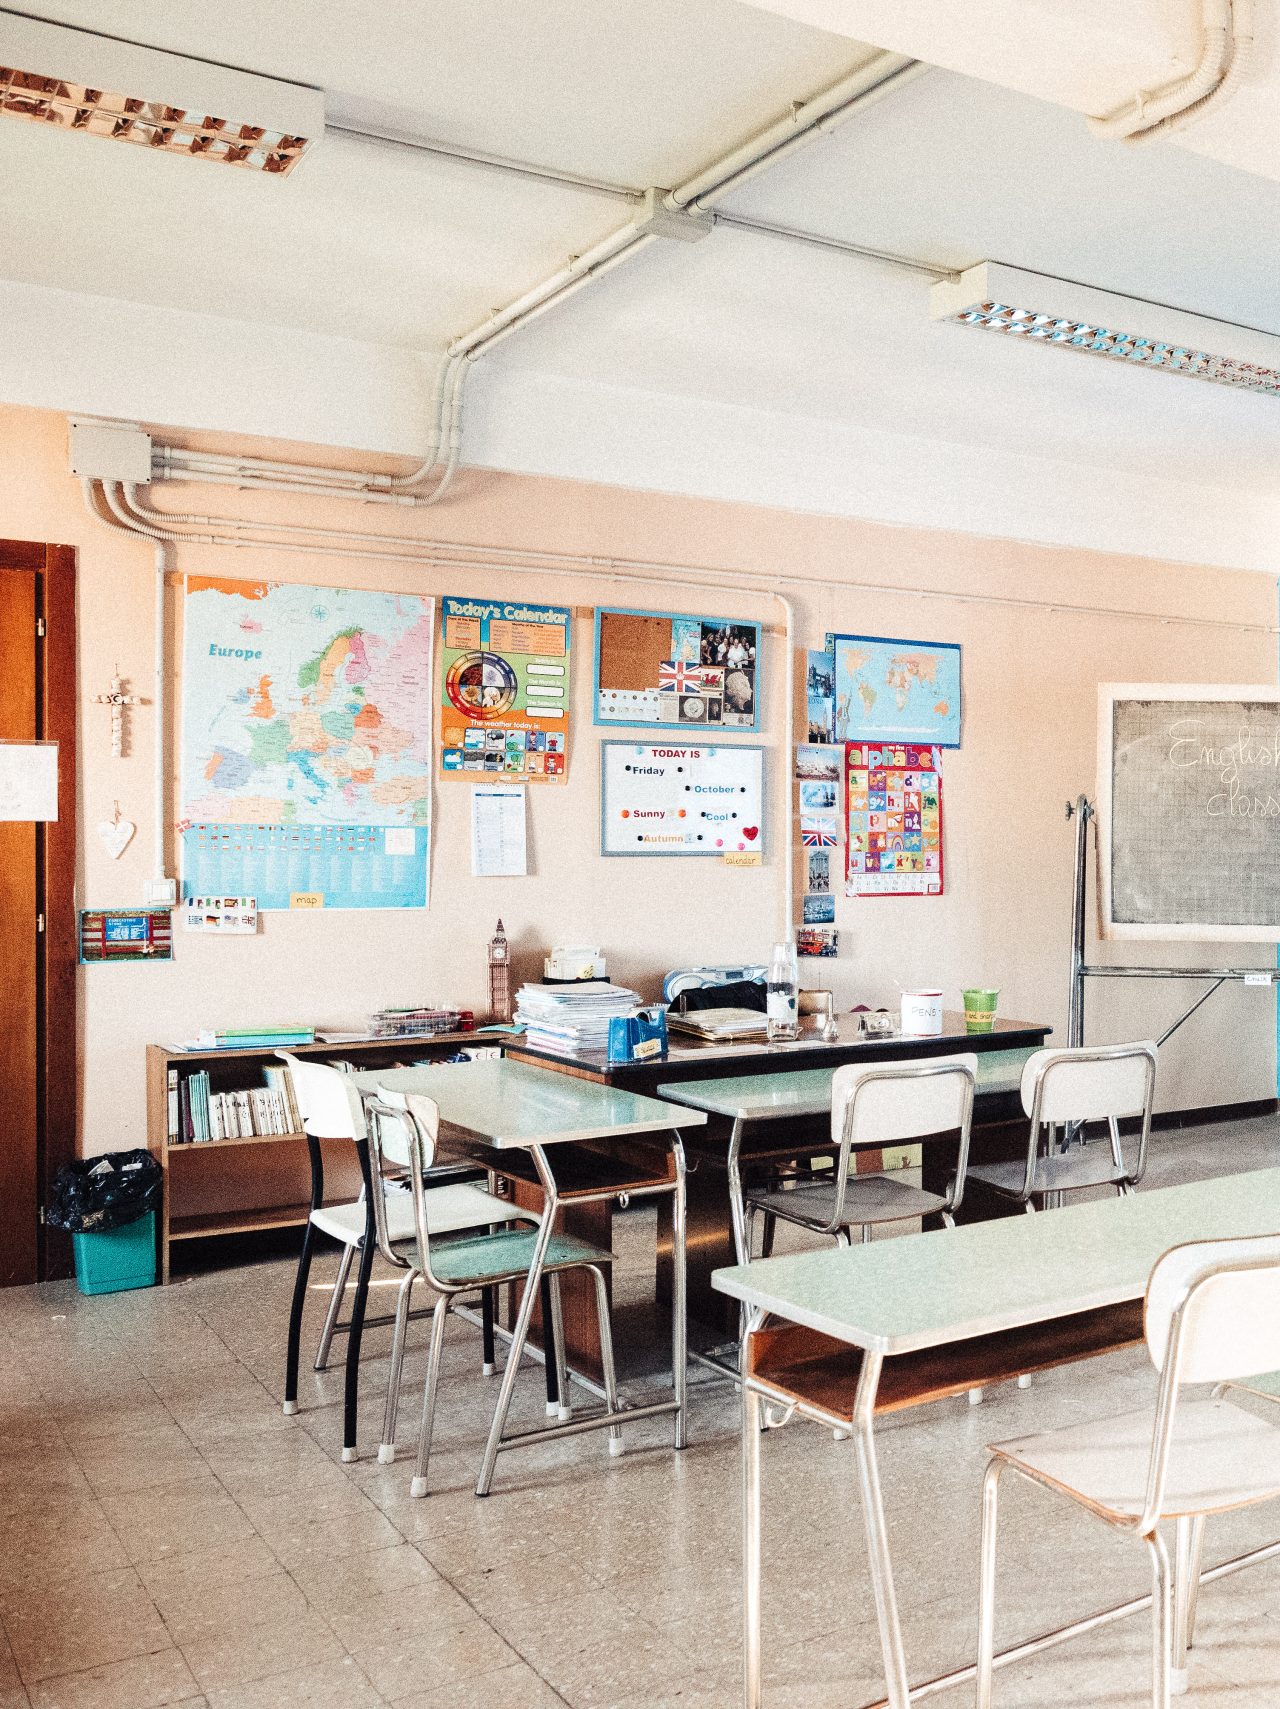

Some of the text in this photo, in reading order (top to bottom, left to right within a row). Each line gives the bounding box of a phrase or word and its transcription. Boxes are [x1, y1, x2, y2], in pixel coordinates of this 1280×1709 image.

[447, 600, 568, 623] Today's Calendar
[208, 643, 263, 662] Europe
[484, 720, 513, 728] weather
[513, 721, 532, 730] today
[652, 749, 700, 758] TODAY IS
[848, 745, 937, 770] alphabe
[633, 767, 665, 776] Friday
[694, 785, 735, 794] October
[633, 810, 665, 819] Sunny
[706, 813, 729, 821] Cool
[644, 835, 684, 843] Autumn
[725, 856, 756, 865] calendar
[296, 896, 318, 907] map
[912, 1006, 936, 1017] PENS
